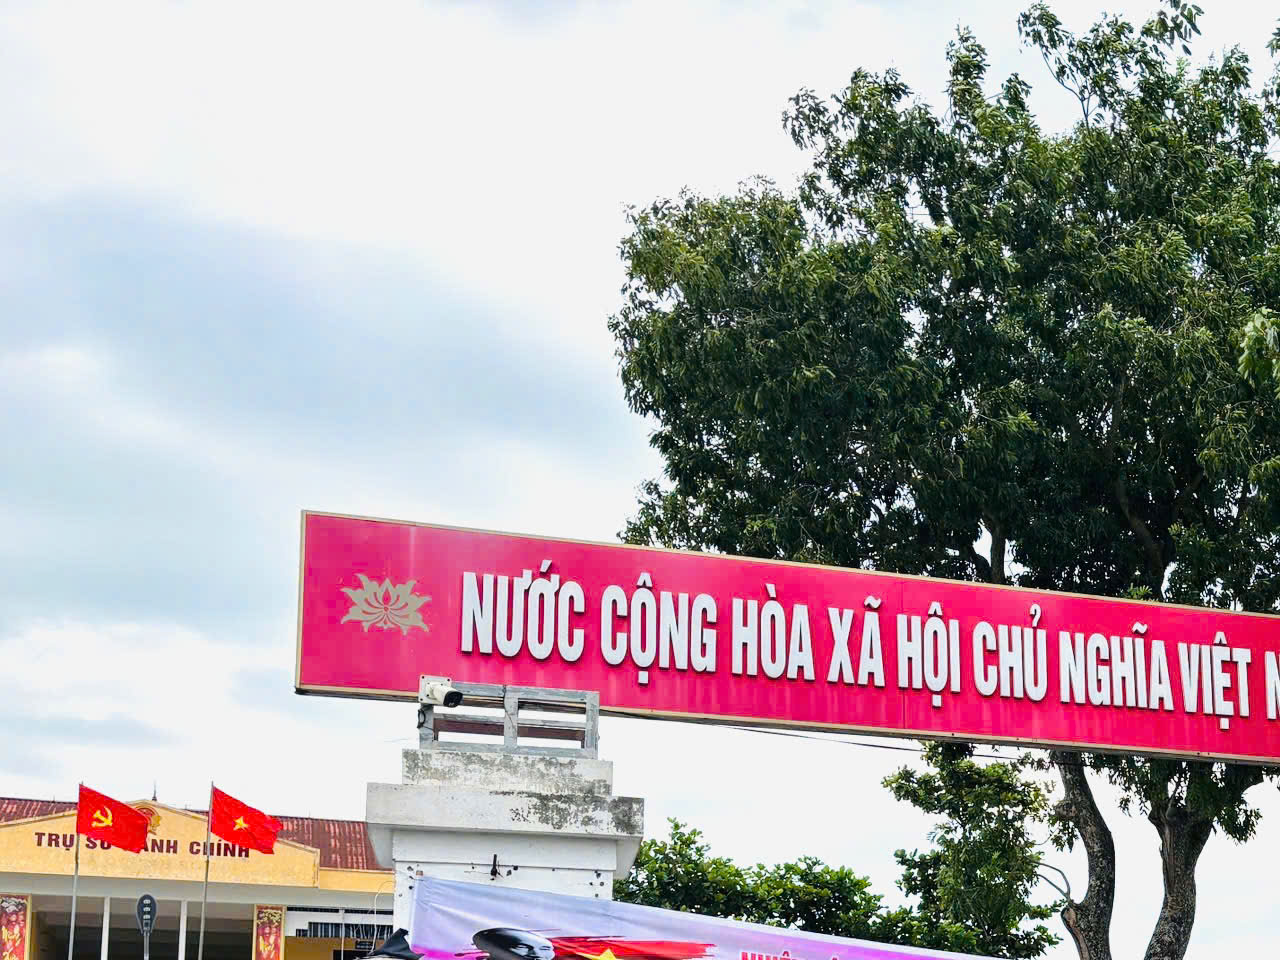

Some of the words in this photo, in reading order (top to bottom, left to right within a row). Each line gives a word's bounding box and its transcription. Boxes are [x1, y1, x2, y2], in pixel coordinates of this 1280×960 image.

[461, 560, 585, 662] NƯỚC
[601, 573, 717, 685] CỘNG
[732, 584, 815, 681] HÒA
[827, 597, 885, 688] XÃ
[897, 602, 961, 707] HỘI
[973, 604, 1047, 702] CHỦ
[1059, 624, 1174, 712] NGHĨA
[1178, 631, 1252, 731] VIỆT
[34, 831, 75, 851] TRỤ
